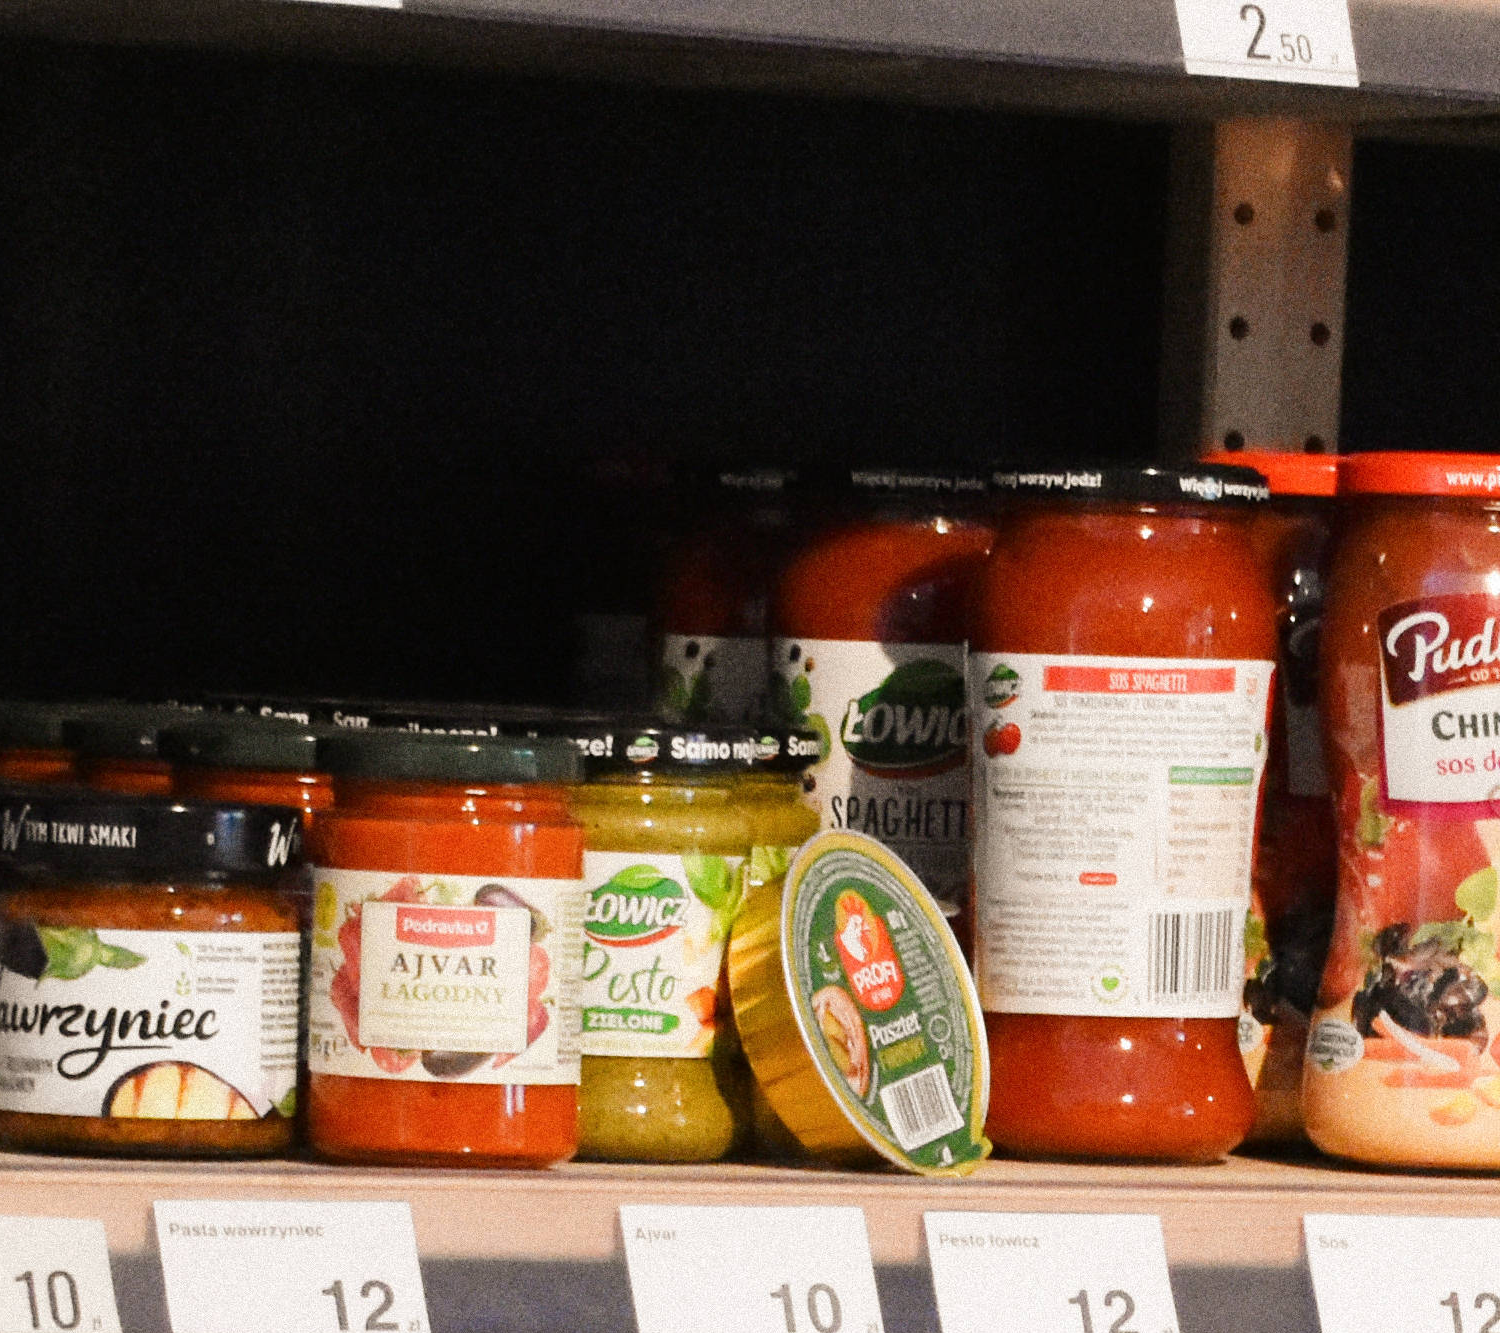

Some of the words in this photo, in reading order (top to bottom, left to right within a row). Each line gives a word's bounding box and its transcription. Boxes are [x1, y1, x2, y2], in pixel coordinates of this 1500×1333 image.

[1109, 671, 1128, 690] SOS
[1132, 672, 1188, 692] SPAGHETTI
[1436, 757, 1478, 777] sos
[830, 795, 967, 838] SPAGHETT
[584, 891, 689, 928] ŁOWICZ
[402, 916, 477, 937] Podravka
[390, 952, 499, 979] AJVAR
[852, 960, 899, 996] PROFI
[868, 1010, 922, 1049] Pasztet
[167, 1221, 215, 1239] Pasta
[635, 1226, 679, 1244] Ajvar
[939, 1232, 986, 1249] Pesto
[1318, 1235, 1349, 1251] Sos
[12, 1269, 81, 1332] 10
[321, 1279, 400, 1333] 12
